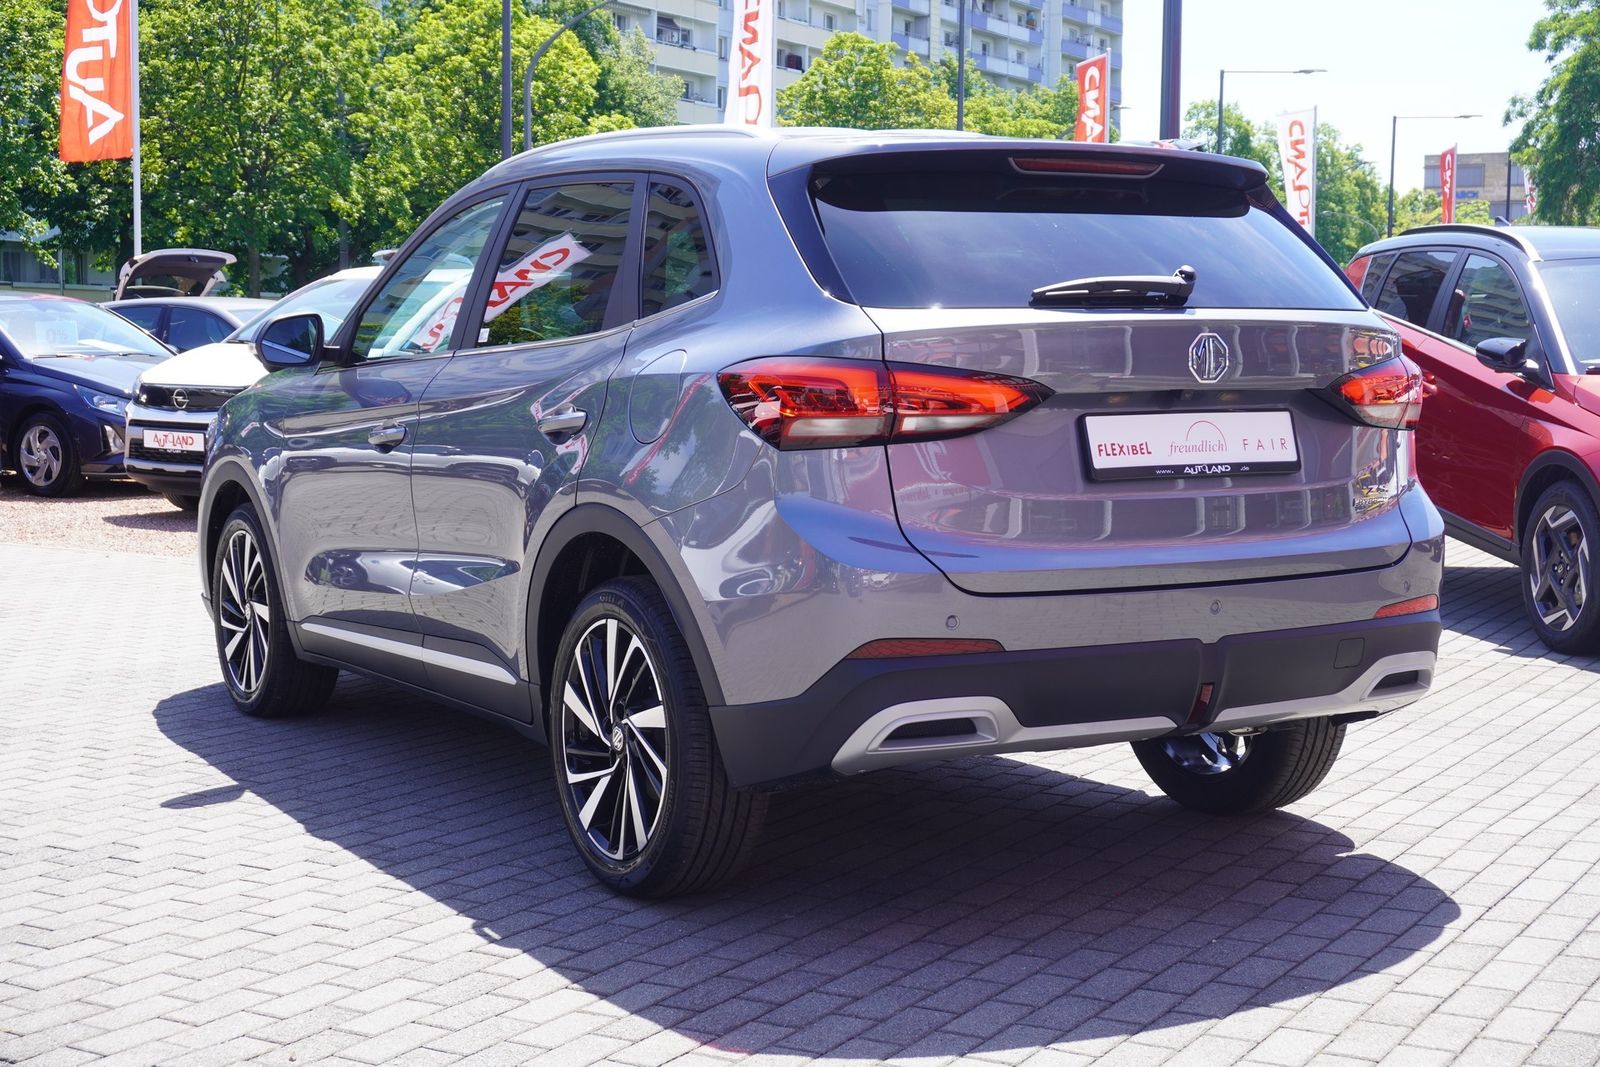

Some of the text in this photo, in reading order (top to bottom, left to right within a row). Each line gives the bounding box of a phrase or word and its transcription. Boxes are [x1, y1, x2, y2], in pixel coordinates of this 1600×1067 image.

[1191, 336, 1226, 379] MG
[1097, 440, 1153, 458] FLEXIBEL
[1167, 440, 1226, 458] freundlich
[1183, 463, 1232, 475] AUTOLAND
